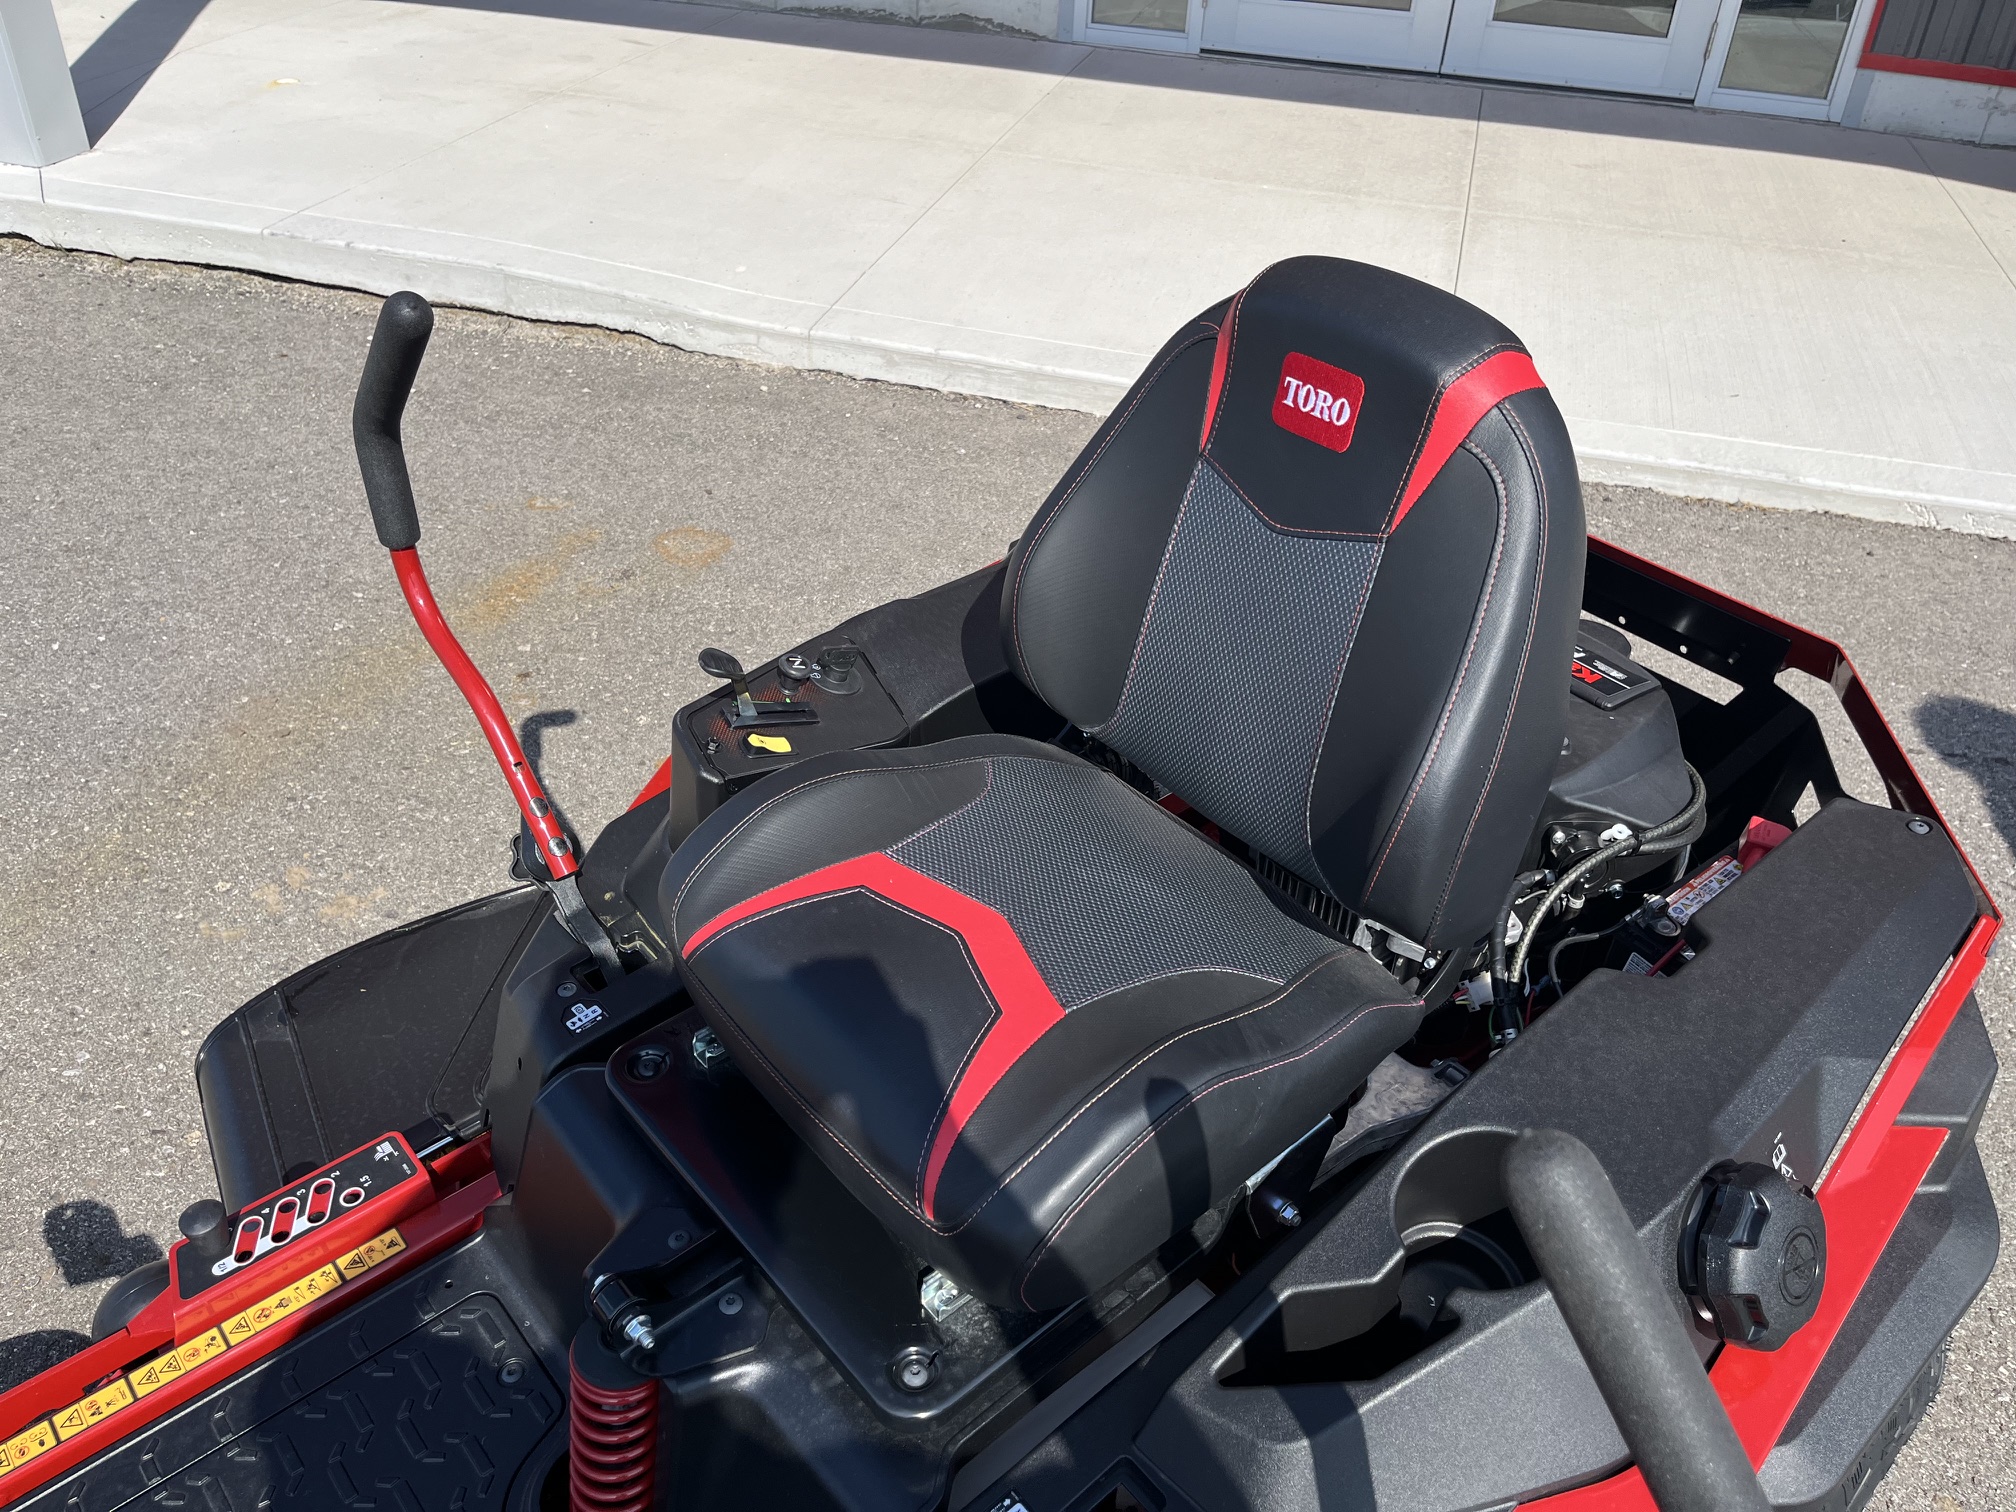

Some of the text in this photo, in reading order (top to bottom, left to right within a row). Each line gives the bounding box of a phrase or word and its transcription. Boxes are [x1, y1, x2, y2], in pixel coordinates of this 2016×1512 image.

[1281, 376, 1351, 427] TORO
[330, 1170, 341, 1178] 2
[359, 1175, 372, 1187] 1.5
[296, 1188, 306, 1196] 3
